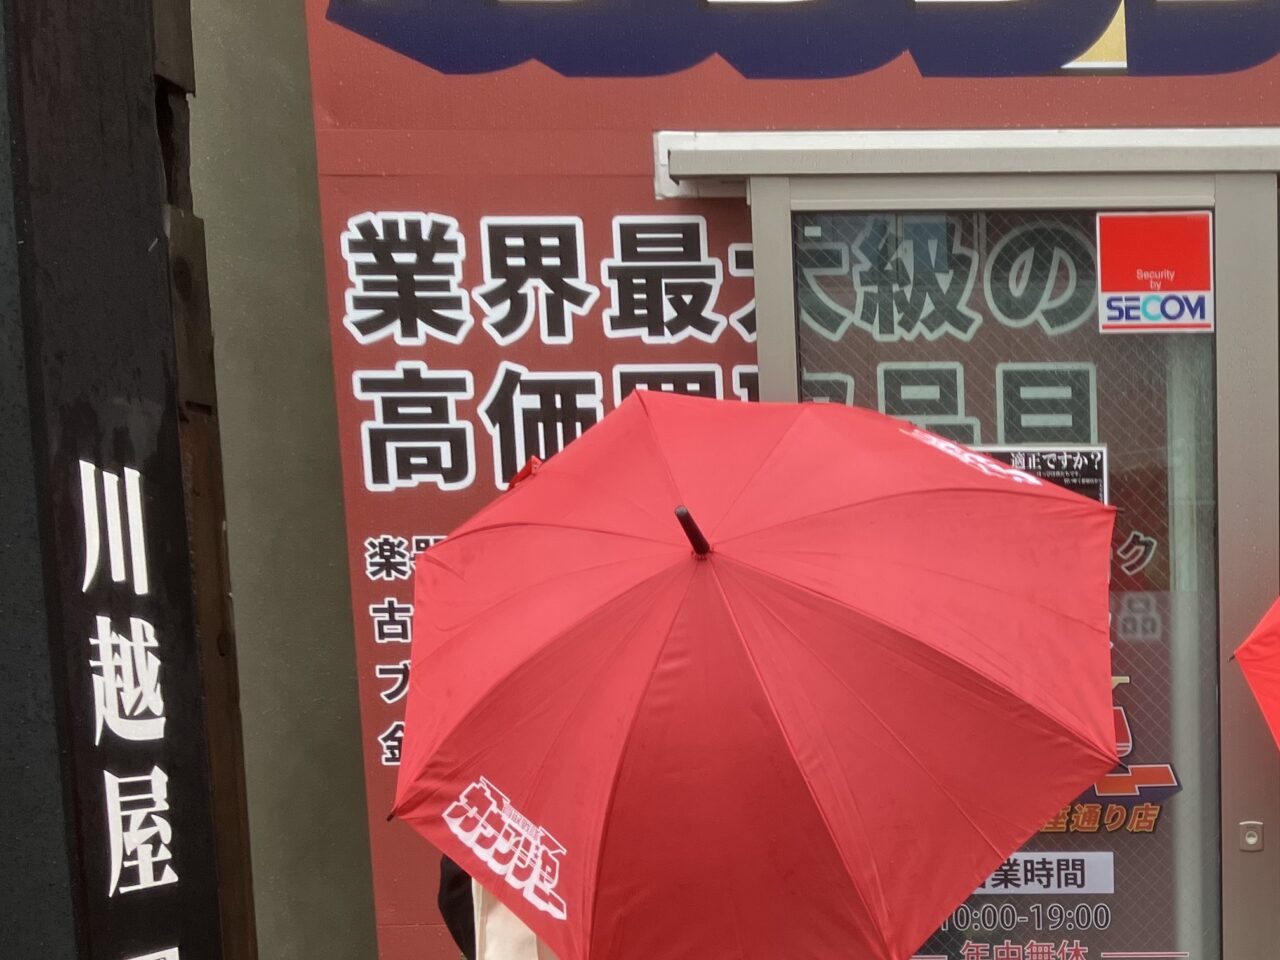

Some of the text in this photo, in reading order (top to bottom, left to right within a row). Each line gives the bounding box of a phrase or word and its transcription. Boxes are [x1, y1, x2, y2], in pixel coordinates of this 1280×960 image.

[1136, 269, 1175, 282] Security
[1150, 279, 1161, 291] by
[1106, 294, 1206, 321] SECOM
[78, 459, 180, 898] 川越屋
